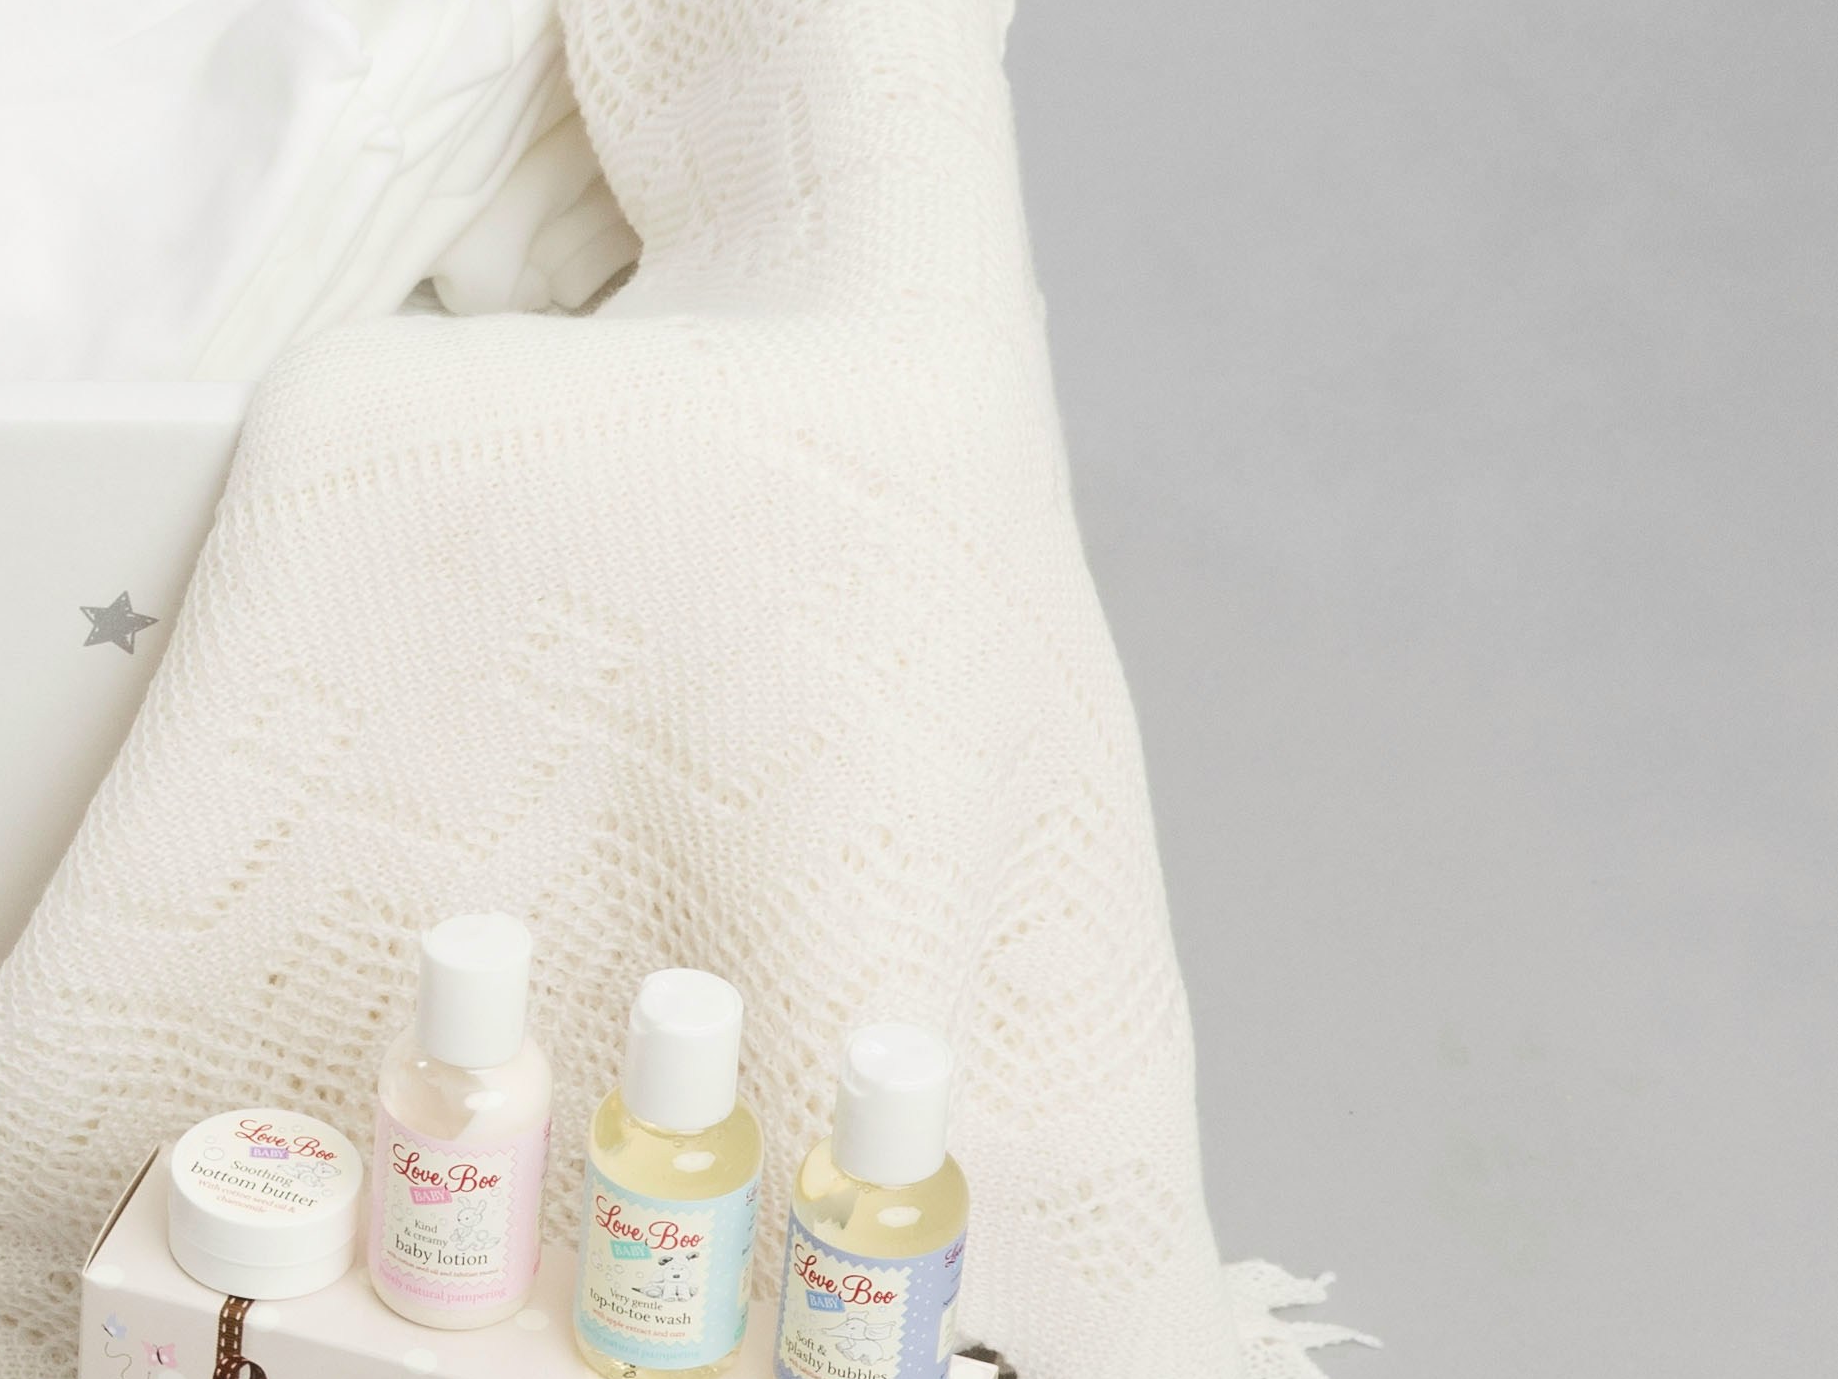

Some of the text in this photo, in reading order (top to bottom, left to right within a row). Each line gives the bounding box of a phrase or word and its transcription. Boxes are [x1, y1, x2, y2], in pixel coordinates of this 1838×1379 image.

[235, 1119, 337, 1161] Love Boo
[253, 1147, 287, 1158] BABY
[230, 1160, 293, 1188] Soothing
[393, 1143, 501, 1192] Love Boo
[191, 1161, 256, 1190] bottom
[261, 1183, 317, 1208] butter
[414, 1190, 445, 1202] BABY
[415, 1219, 437, 1233] Kind
[596, 1195, 704, 1249] Love Boo
[395, 1234, 433, 1264] baby
[437, 1250, 488, 1266] lotion
[413, 1232, 448, 1248] creamy
[615, 1244, 645, 1256] BABY
[794, 1243, 897, 1304] Love Boo
[590, 1288, 691, 1324] top-to-toe wash
[610, 1288, 663, 1310] Very gentle
[810, 1294, 840, 1309] BABY
[796, 1330, 826, 1356] Soft &
